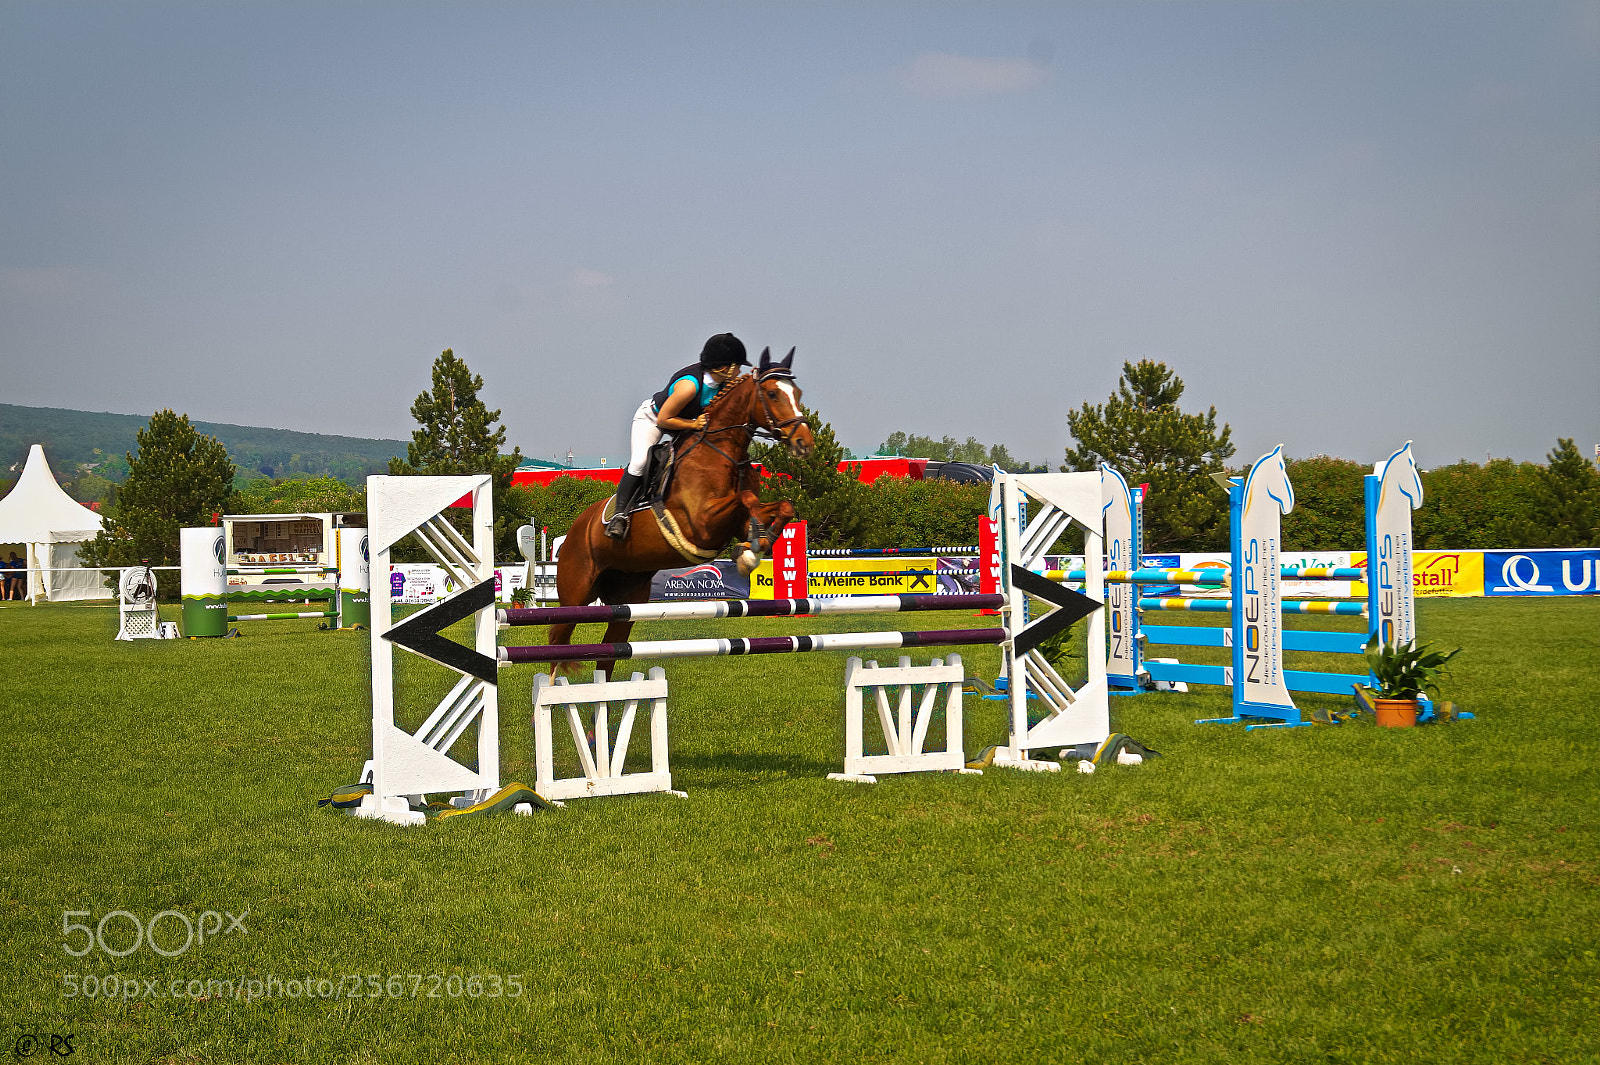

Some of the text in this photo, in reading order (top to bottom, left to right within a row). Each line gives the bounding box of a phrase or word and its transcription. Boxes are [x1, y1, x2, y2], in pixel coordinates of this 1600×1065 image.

[664, 580, 726, 589] ARENA NOVA
[823, 575, 865, 587] Meine
[869, 575, 903, 587] Bank
[1379, 534, 1393, 645] OEPS
[1562, 559, 1600, 592] U
[1244, 538, 1260, 684] NOEPS
